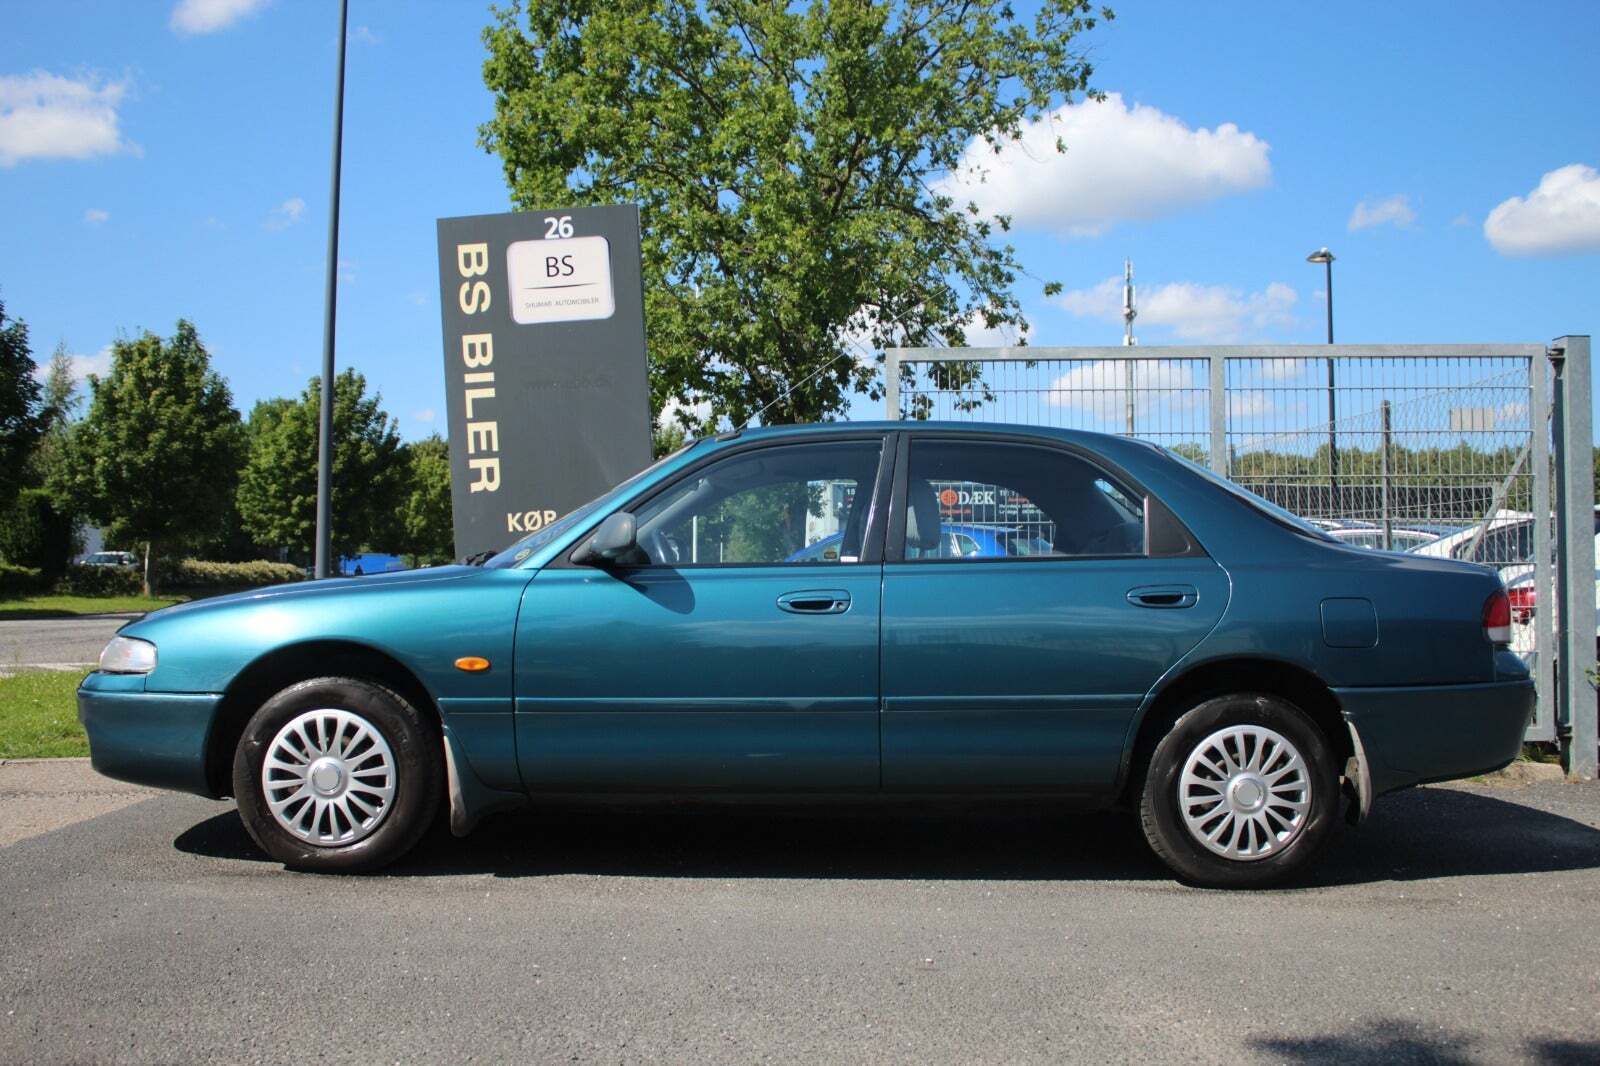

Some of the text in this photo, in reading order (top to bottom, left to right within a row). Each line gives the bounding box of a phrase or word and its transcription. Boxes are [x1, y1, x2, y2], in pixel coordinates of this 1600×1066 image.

[544, 215, 574, 240] 26
[545, 255, 575, 278] BS
[456, 242, 501, 494] BS BILER
